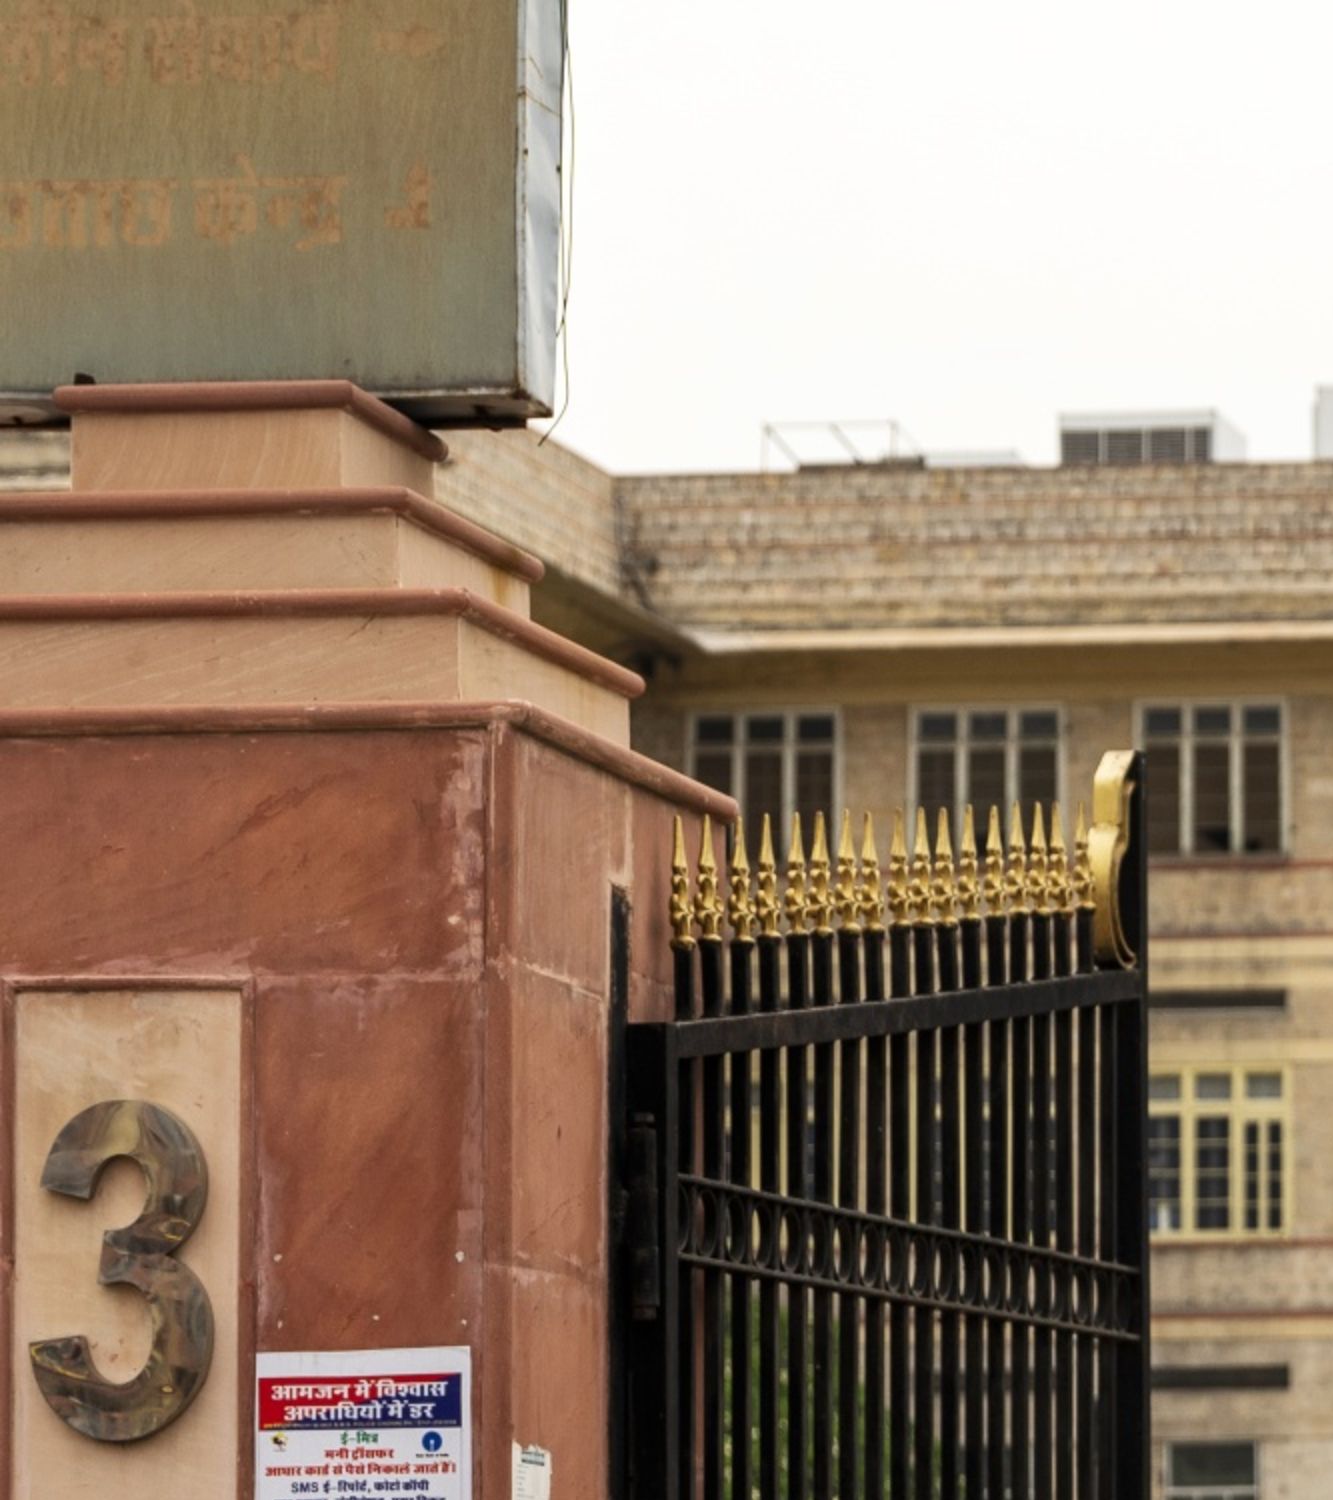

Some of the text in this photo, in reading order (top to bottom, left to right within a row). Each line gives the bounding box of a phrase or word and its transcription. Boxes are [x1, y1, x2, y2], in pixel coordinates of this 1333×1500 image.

[29, 1100, 215, 1442] 3
[271, 1378, 448, 1400] आमजन में विश्वास
[284, 1400, 436, 1421] अपराधियों में डर
[324, 1446, 349, 1459] मनी
[265, 1466, 302, 1477] आधार
[304, 1463, 330, 1476] कार्ड
[333, 1464, 343, 1475] से
[345, 1462, 365, 1475] पैसे
[368, 1461, 410, 1475] निकाले
[414, 1461, 438, 1474] जाते
[291, 1482, 319, 1493] SMS
[374, 1479, 400, 1491] फोटो
[402, 1478, 429, 1491] कॉपी
